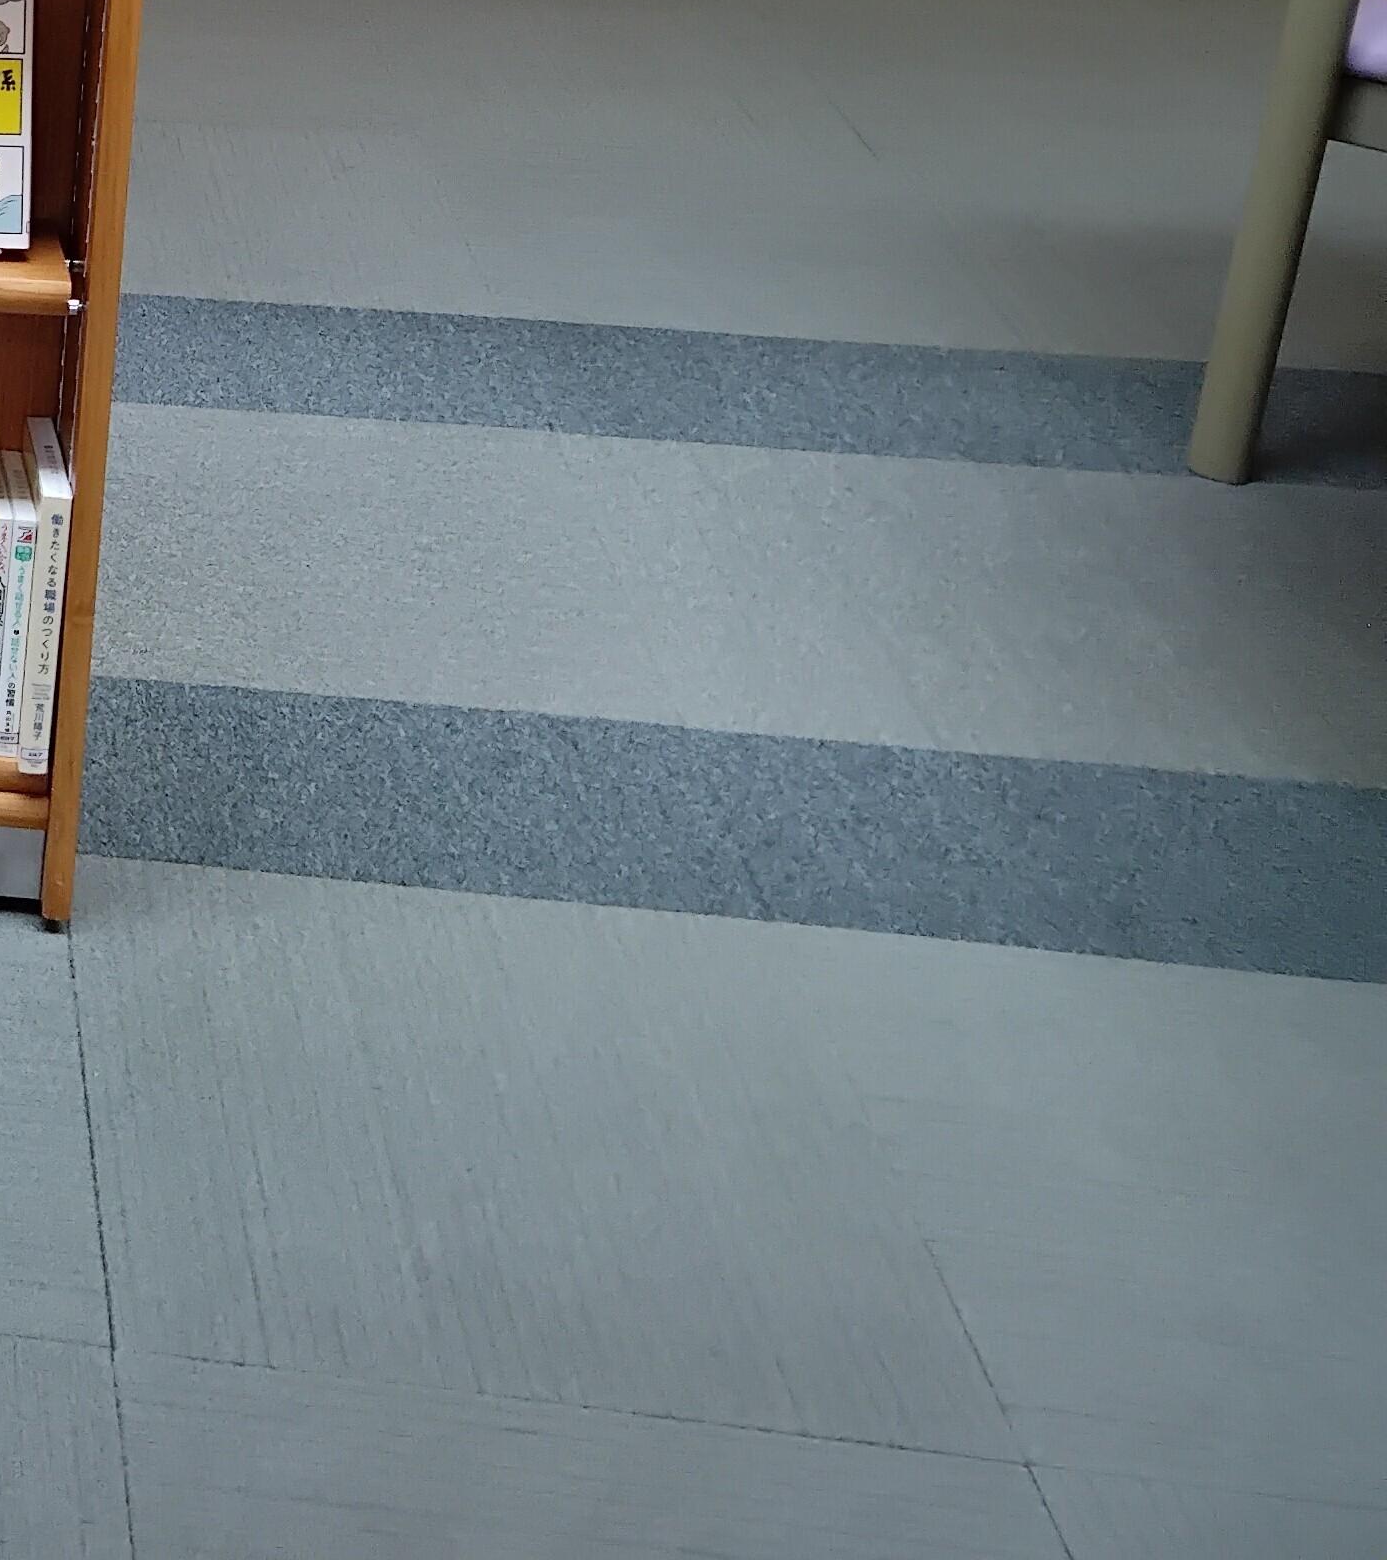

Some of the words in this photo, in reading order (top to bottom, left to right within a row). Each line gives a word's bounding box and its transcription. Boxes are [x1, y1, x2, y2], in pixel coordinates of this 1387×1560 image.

[37, 513, 65, 676] 働きたくなる職場のつくり方
